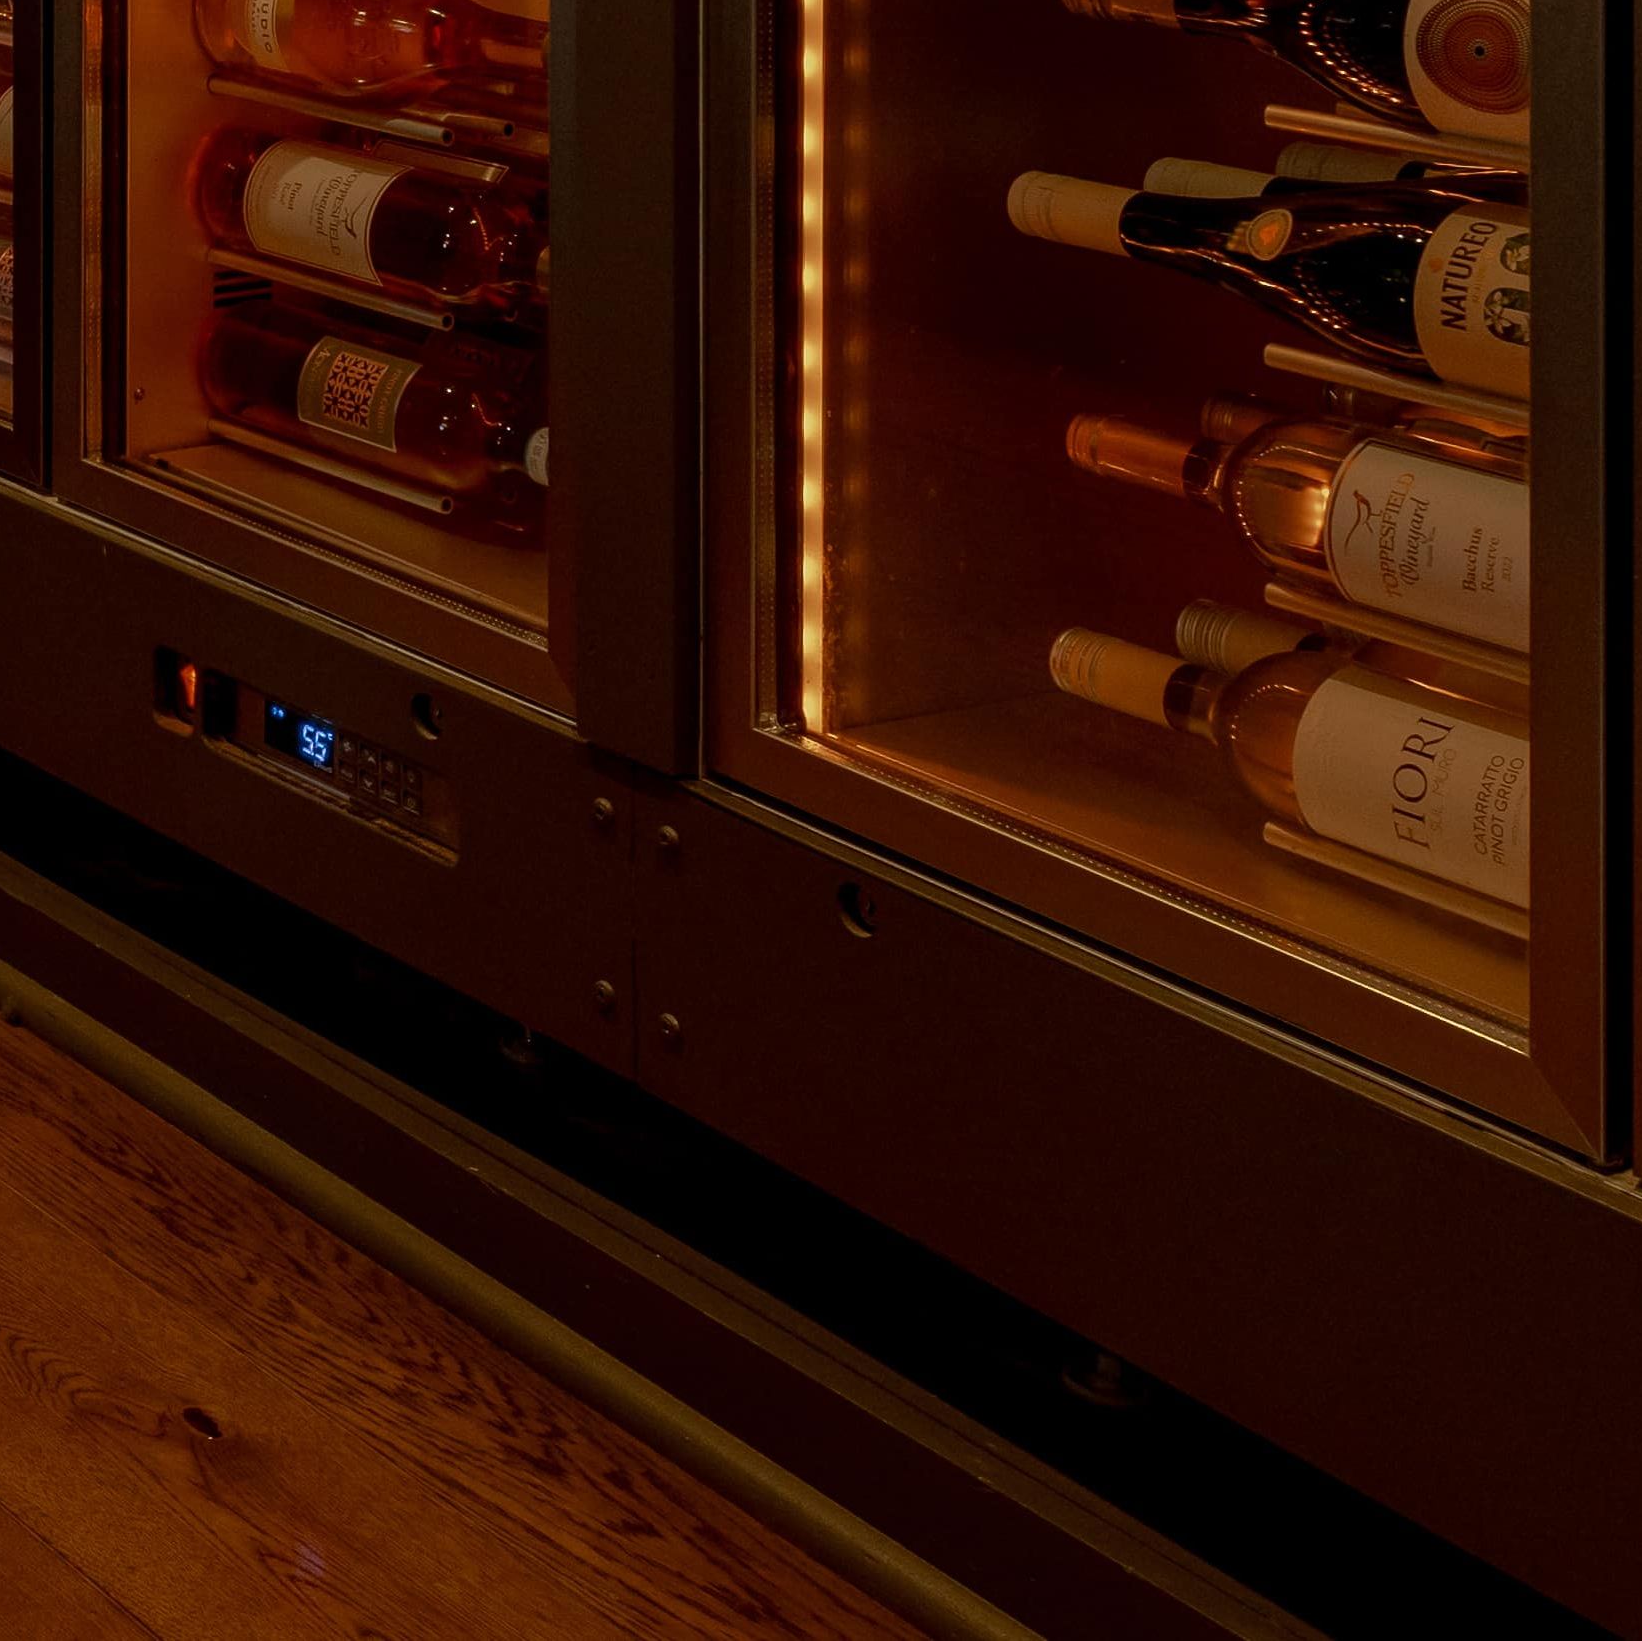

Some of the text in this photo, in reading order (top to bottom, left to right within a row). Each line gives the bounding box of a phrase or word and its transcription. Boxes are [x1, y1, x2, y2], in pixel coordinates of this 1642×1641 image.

[315, 176, 343, 237] Vineyard
[1440, 221, 1497, 331] NATUREO
[1377, 472, 1415, 598] TOPPESFIELD
[1397, 497, 1430, 586] Vineyard
[1462, 527, 1484, 593] Bacchus
[1480, 536, 1500, 593] Reserve
[1391, 716, 1456, 849] FIORI
[1473, 755, 1506, 855] CATARRATTO
[1494, 757, 1525, 812] GRIGIO
[1492, 815, 1508, 866] PINOT
